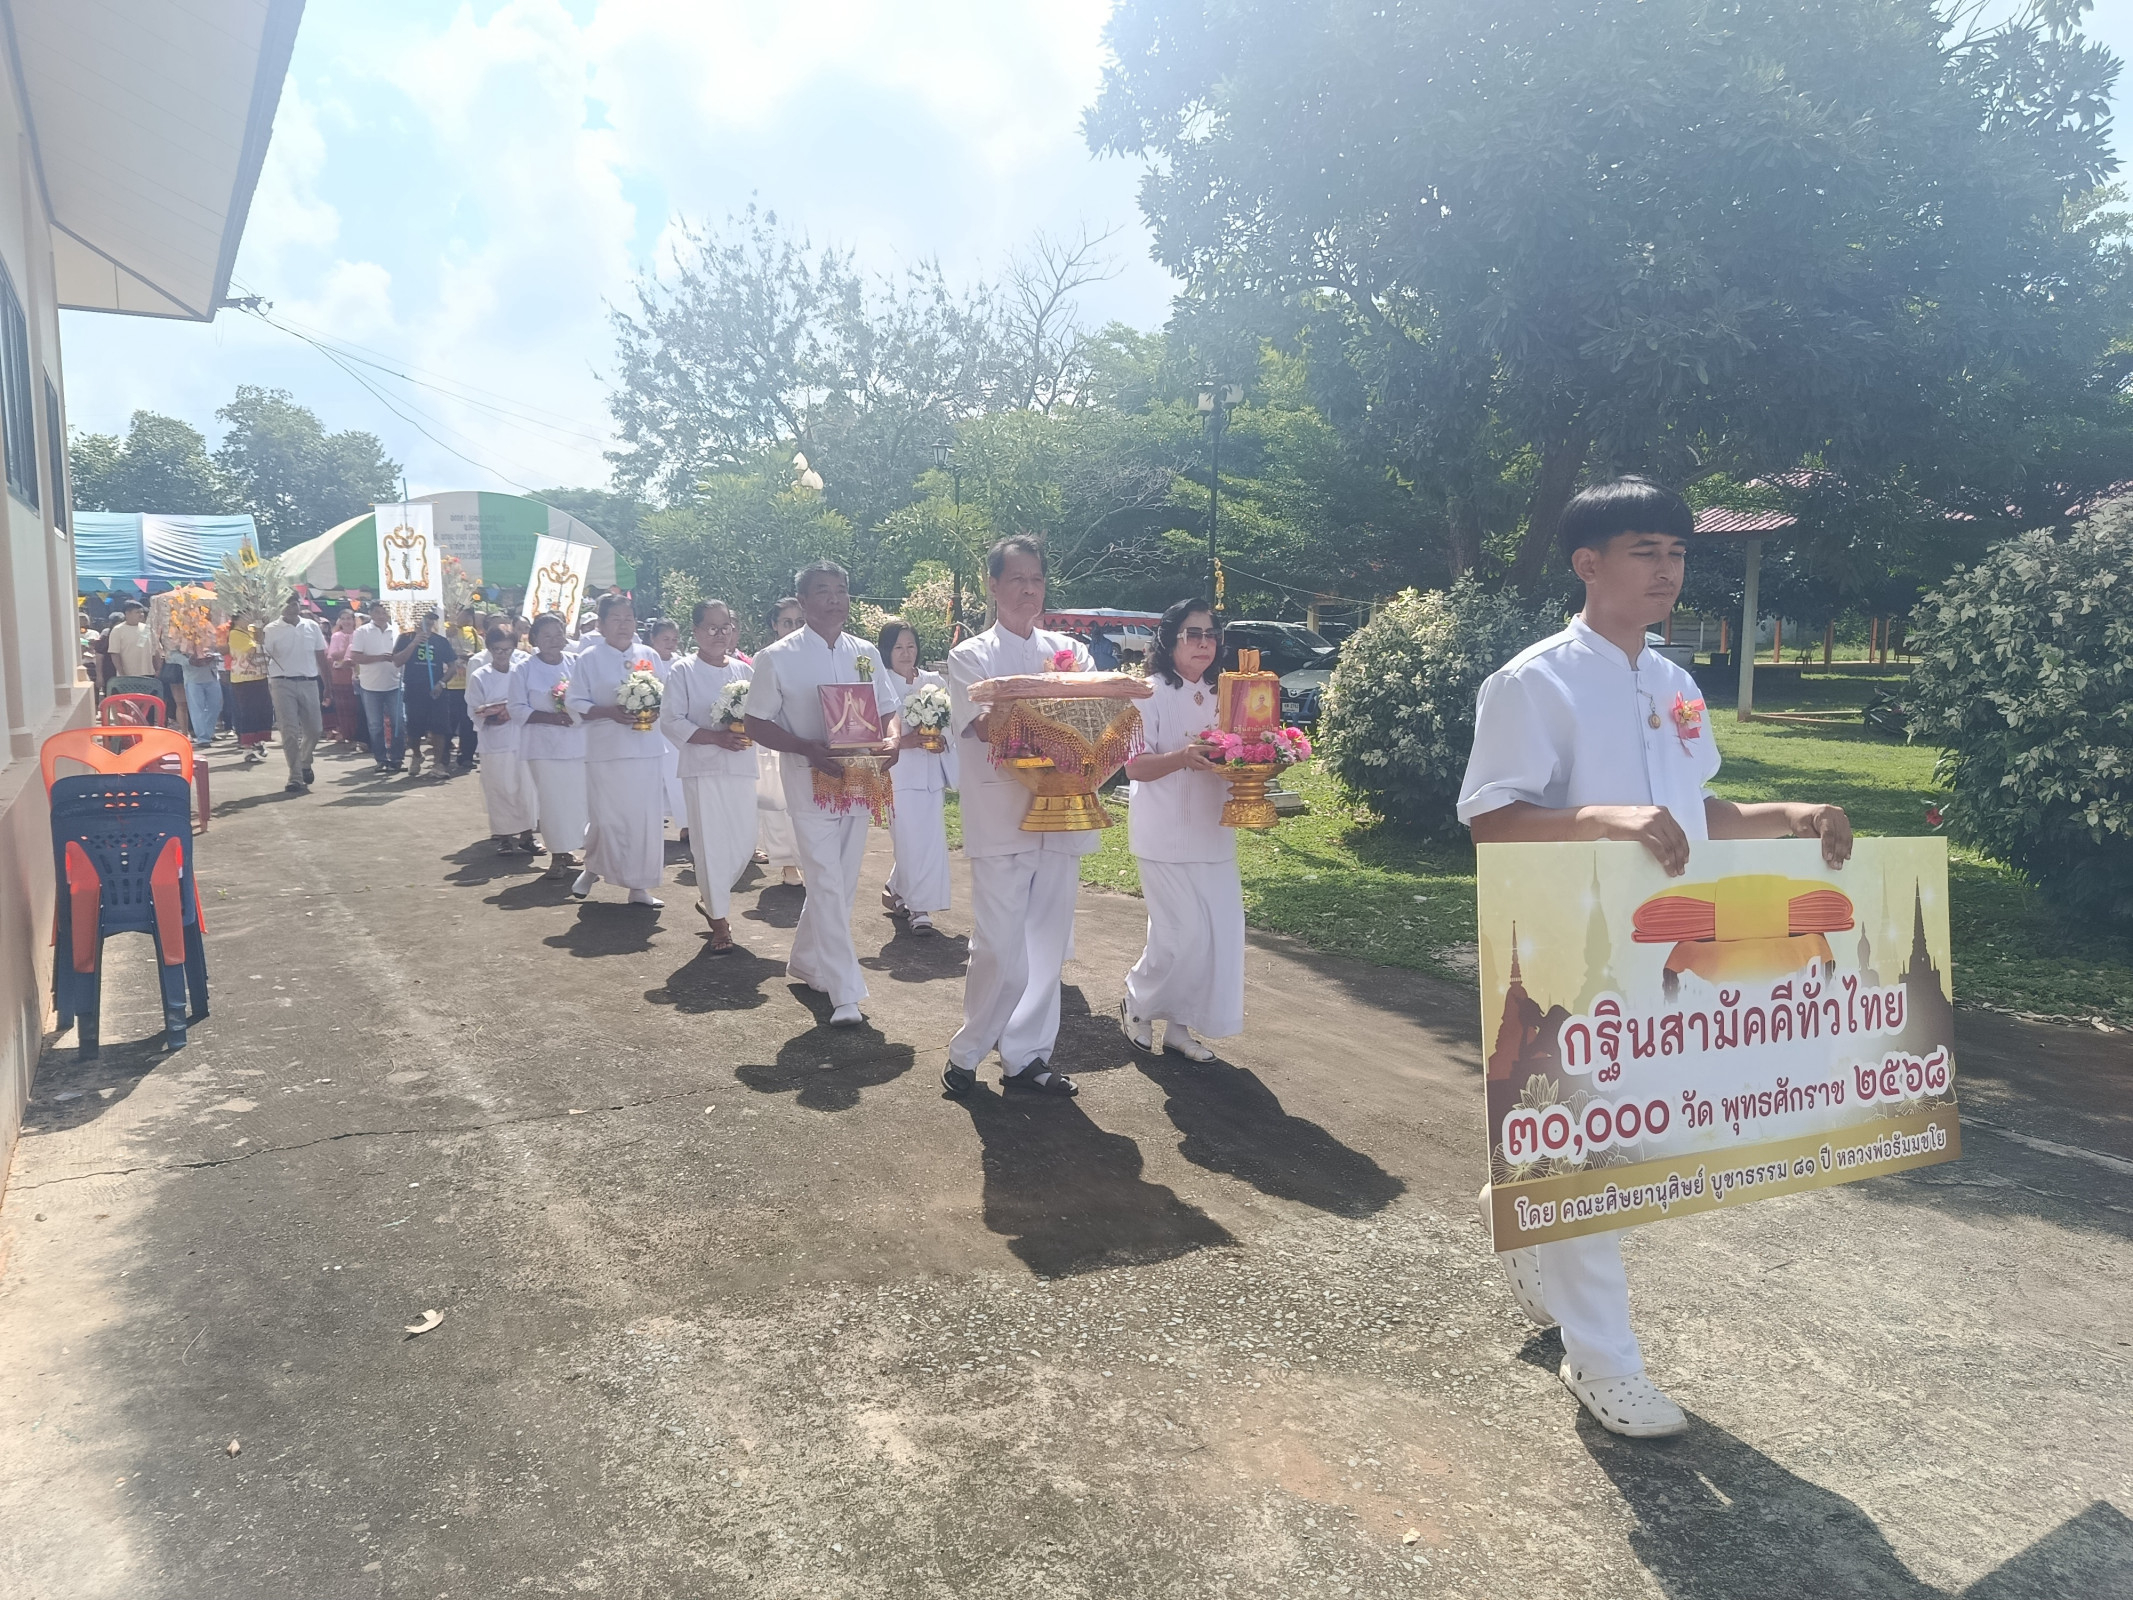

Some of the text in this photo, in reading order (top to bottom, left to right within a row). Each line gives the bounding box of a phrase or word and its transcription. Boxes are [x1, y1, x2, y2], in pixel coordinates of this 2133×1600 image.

[1564, 964, 1904, 1082] กฐินสามัคคีทั่วไทย
[1508, 1051, 1947, 1158] ๓๐,๐๐๐ วัด พุทธศักราช ๒๕๖๘
[1516, 1201, 1554, 1230] โดย
[1562, 1168, 1704, 1220] คณะศิษยานุศิษย์
[1711, 1160, 1788, 1198] บูชาธรรม
[1793, 1159, 1815, 1178] ๘๑
[1821, 1147, 1832, 1171] ปี
